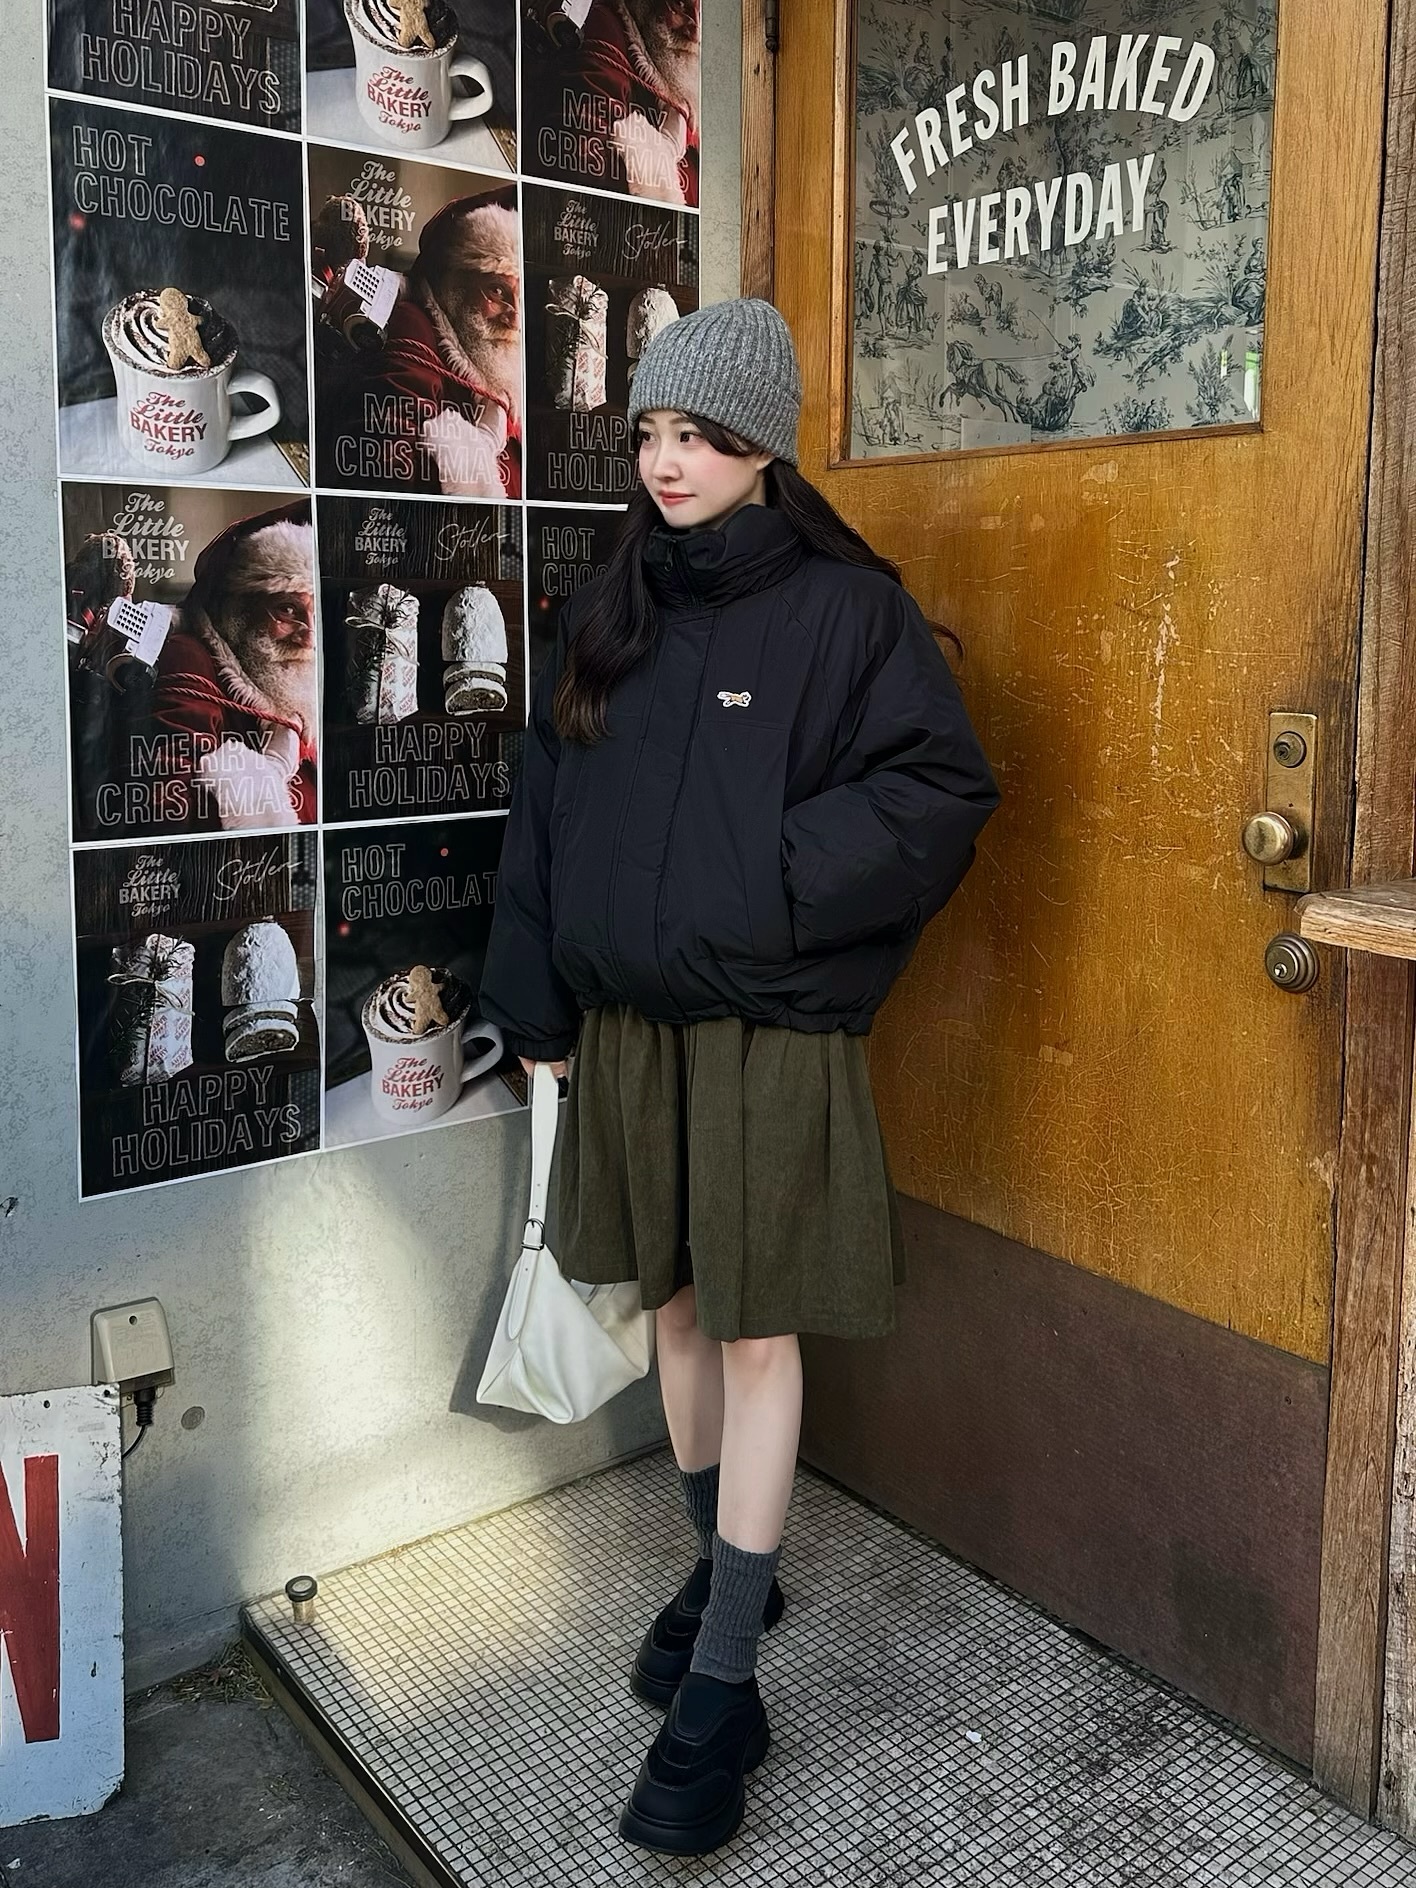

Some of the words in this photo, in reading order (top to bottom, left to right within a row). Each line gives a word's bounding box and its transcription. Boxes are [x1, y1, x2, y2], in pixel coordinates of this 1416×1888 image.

[112, 0, 251, 60] HAPPY
[80, 32, 281, 114] HOLIDAYS
[380, 66, 414, 85] The
[369, 72, 430, 100] Little
[367, 83, 432, 118] BAKERY
[378, 110, 422, 133] Tokyo
[563, 88, 668, 143] MERRY
[890, 54, 1029, 195] FRESH
[1048, 34, 1216, 122] BAKED
[72, 125, 153, 176] HOT
[538, 127, 690, 193] CRISTMAS
[361, 160, 396, 181] The
[345, 178, 412, 208] Little
[74, 171, 291, 241] CHOCOLATE
[565, 199, 587, 214] The
[928, 153, 1155, 275] EVERYDAY
[355, 226, 403, 250] Tokyo
[553, 226, 600, 247] BAKERY
[132, 400, 204, 424] Little
[146, 392, 186, 407] The
[129, 411, 208, 442] BAKERY
[363, 392, 485, 438] MERRY
[144, 438, 195, 460] Tokyo
[335, 434, 511, 487] CRISTMAS
[124, 492, 165, 513] The
[368, 507, 393, 521] The
[107, 512, 185, 537] Little
[357, 520, 405, 538] Little
[354, 536, 408, 553] BAKERY
[541, 526, 596, 560] HOT
[365, 551, 399, 569] Tokyo
[119, 561, 176, 585] Tokyo
[130, 731, 274, 778] MERRY
[375, 722, 486, 764] HAPPY
[349, 761, 511, 809] HOLIDAYS
[96, 774, 304, 827] CRISTMAS
[135, 854, 164, 869] The
[341, 843, 406, 883] HOT
[122, 868, 178, 888] Little
[119, 883, 181, 905] BAKERY
[131, 902, 171, 918] Tokyo
[381, 1063, 442, 1082] Little
[394, 1058, 427, 1070] The
[142, 1065, 274, 1126] HAPPY
[381, 1073, 445, 1098] BAKERY
[391, 1096, 433, 1113] Tokyo
[111, 1104, 301, 1178] HOLIDAYS
